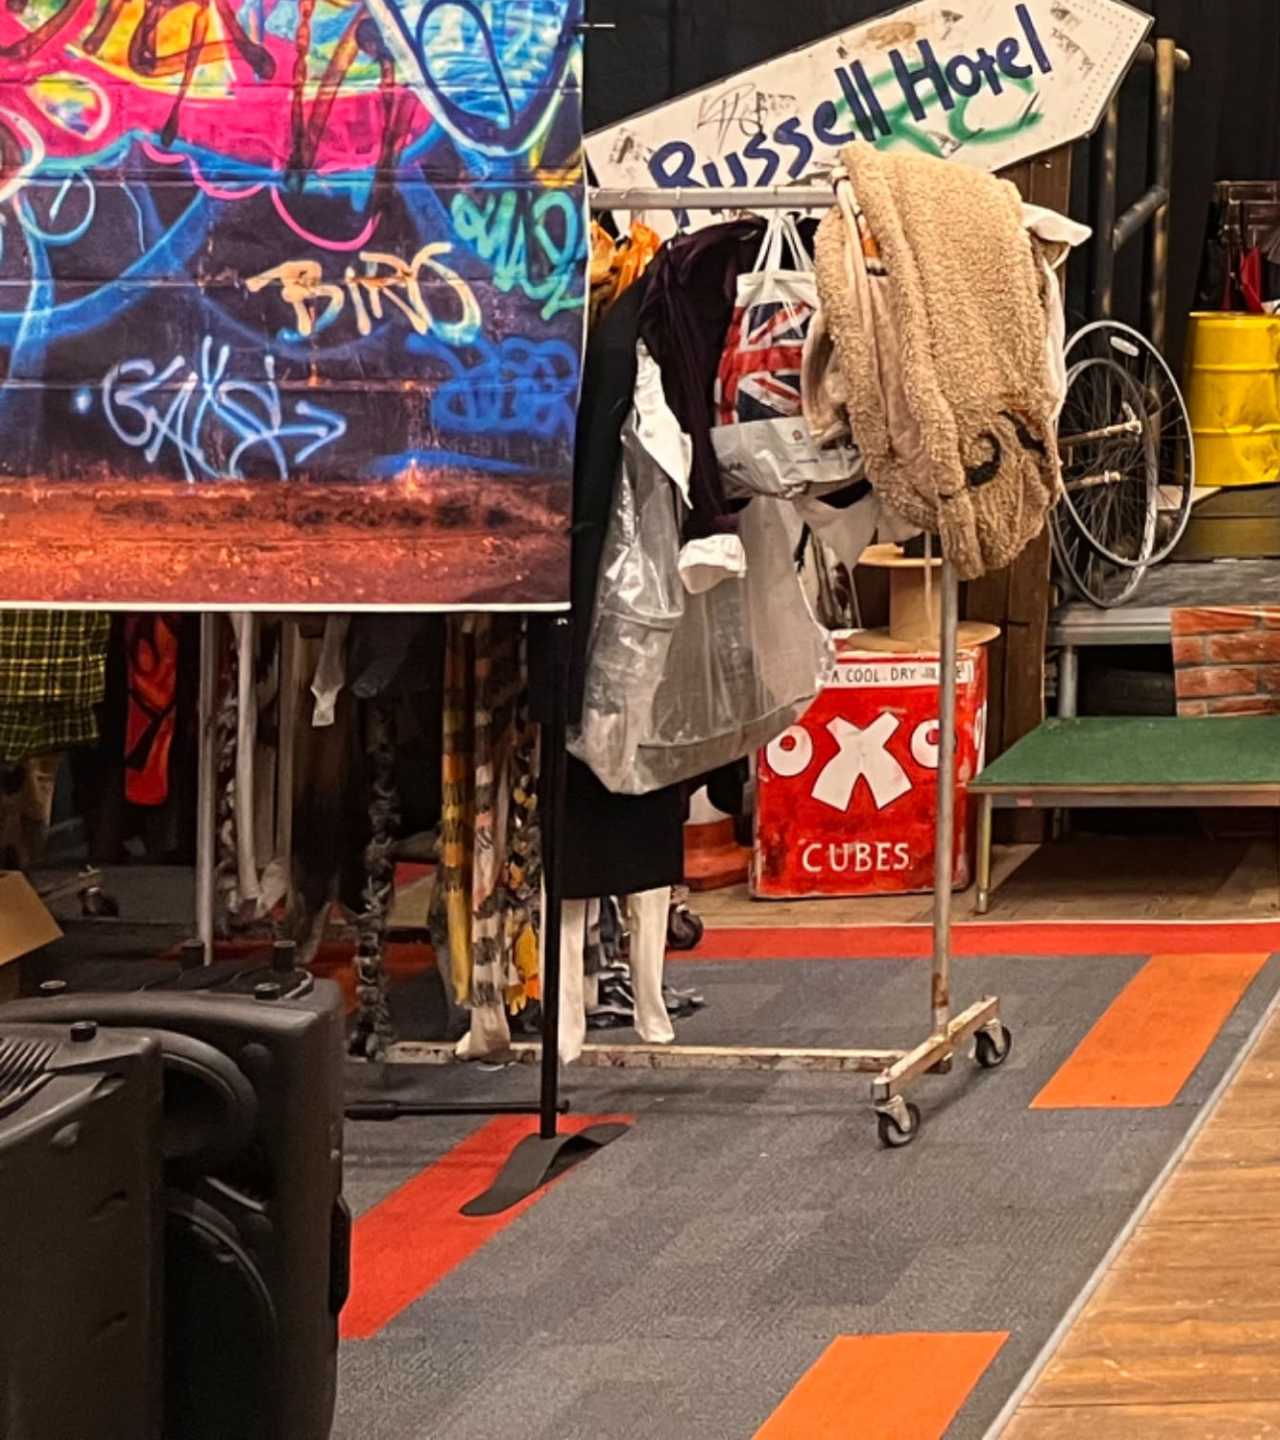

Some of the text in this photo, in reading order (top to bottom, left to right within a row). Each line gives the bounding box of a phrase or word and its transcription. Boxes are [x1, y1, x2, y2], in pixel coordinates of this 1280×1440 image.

[648, 59, 892, 226] Russell
[889, 2, 1052, 122] Hotel
[845, 667, 880, 683] COOL
[890, 666, 917, 681] DRY
[766, 711, 957, 812] OXO
